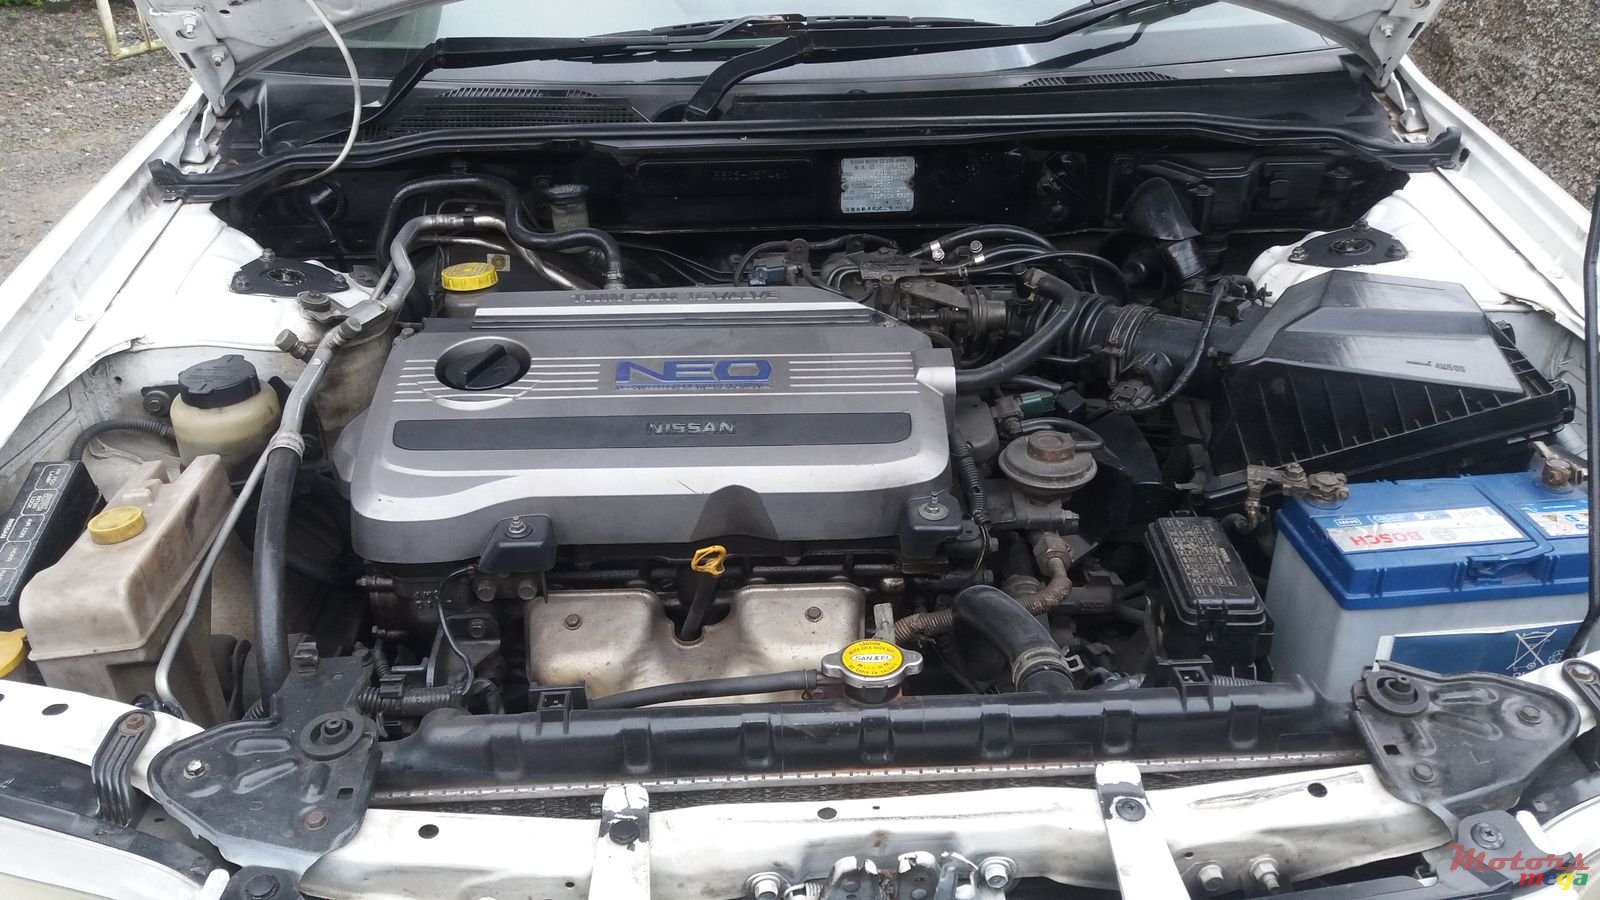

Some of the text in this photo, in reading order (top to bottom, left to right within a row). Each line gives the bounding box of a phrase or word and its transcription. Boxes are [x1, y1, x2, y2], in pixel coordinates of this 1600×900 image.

[570, 293, 625, 303] TWIN
[632, 291, 678, 302] CAM
[615, 359, 773, 383] NEO
[647, 421, 736, 435] NISSAN
[1350, 530, 1424, 546] BOSCH
